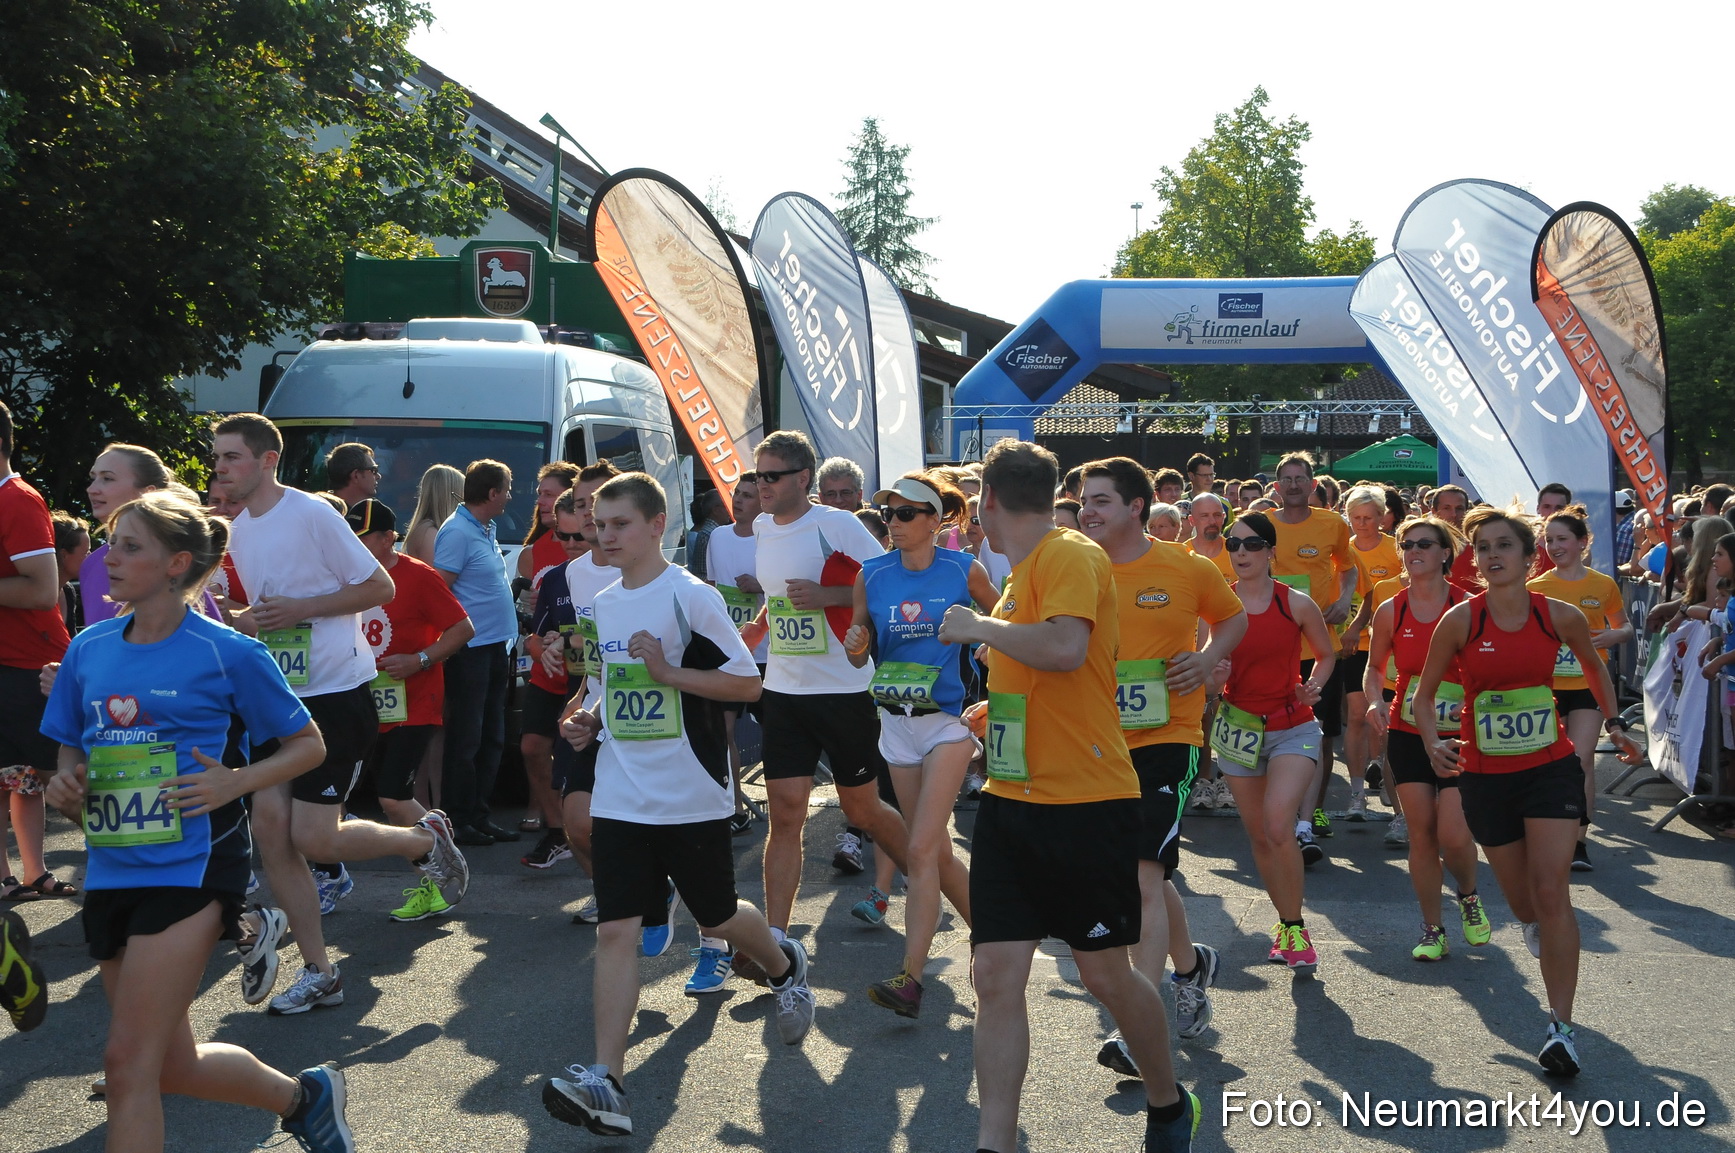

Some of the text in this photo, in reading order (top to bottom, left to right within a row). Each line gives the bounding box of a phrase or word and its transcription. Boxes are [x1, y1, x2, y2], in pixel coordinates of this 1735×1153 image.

[491, 301, 517, 311] 1628
[1227, 300, 1260, 310] Fischer
[1201, 318, 1301, 338] firmenlauf
[1201, 337, 1243, 345] neumarkt
[1015, 352, 1068, 365] Fischer
[888, 605, 898, 624] I
[362, 619, 383, 647] 8
[775, 617, 816, 641] 305
[889, 622, 934, 634] camping
[873, 685, 932, 704] 5043
[1115, 684, 1147, 712] 45
[90, 700, 105, 729] I
[613, 690, 666, 721] 202
[1478, 709, 1552, 740] 1307
[95, 727, 158, 746] camping
[1214, 716, 1259, 756] 1312
[86, 789, 175, 833] 5044
